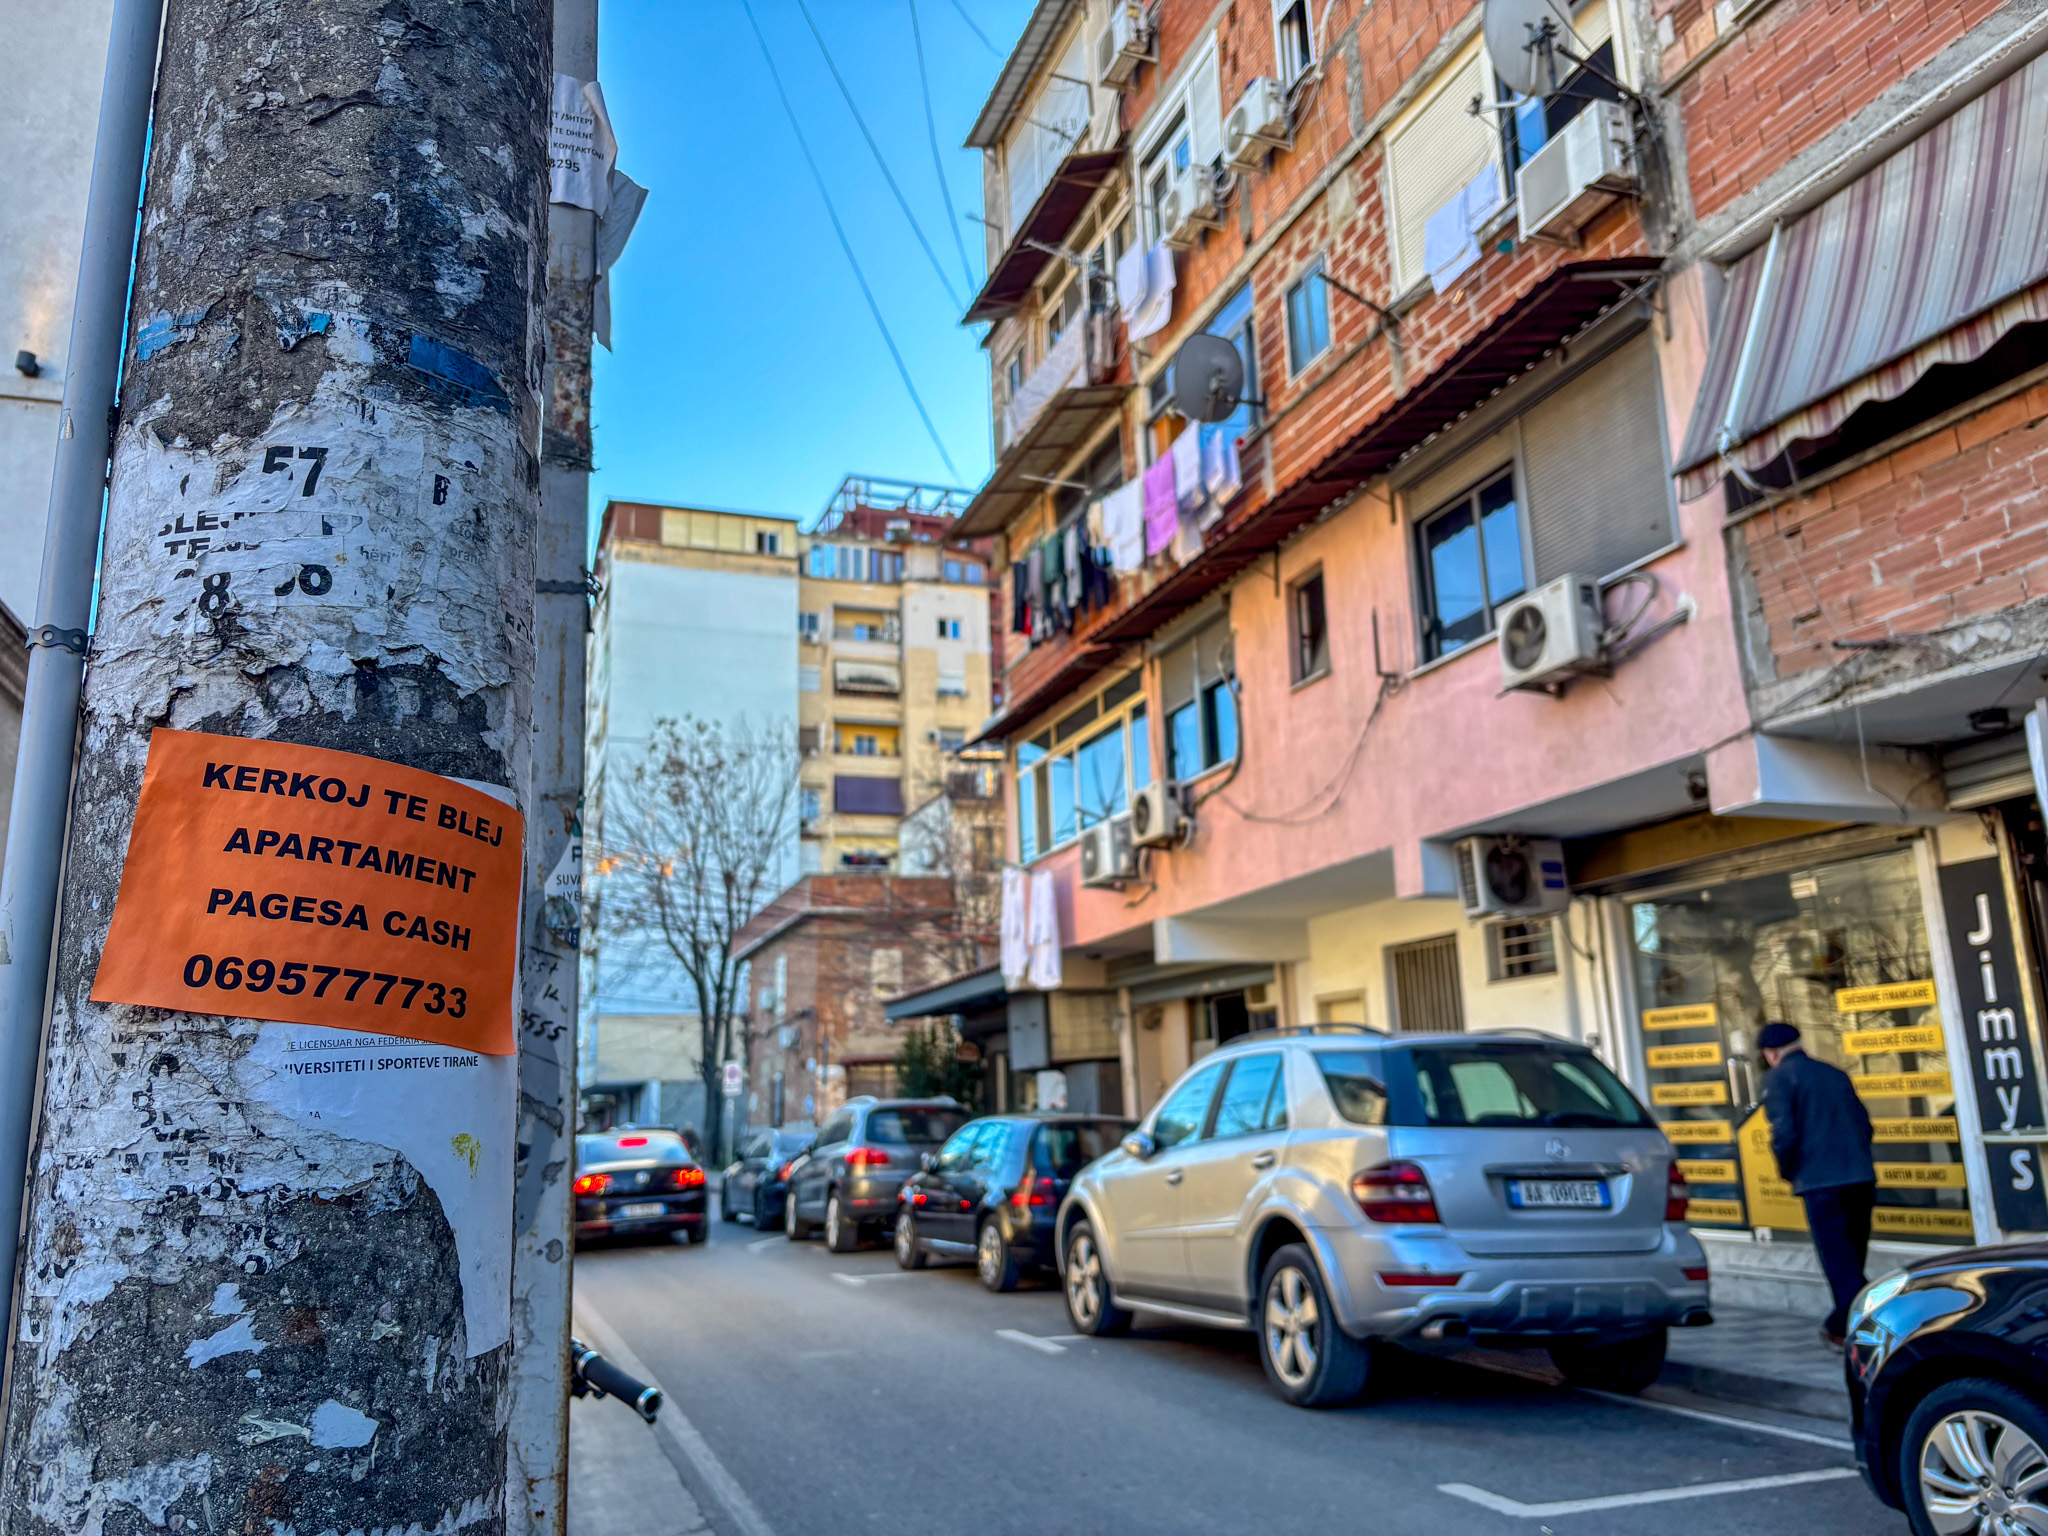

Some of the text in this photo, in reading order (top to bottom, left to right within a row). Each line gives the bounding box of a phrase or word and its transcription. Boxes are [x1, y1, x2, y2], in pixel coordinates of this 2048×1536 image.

[202, 762, 503, 848] KERKOJ TE BLEJ
[223, 827, 477, 894] APARTAMENT
[206, 888, 471, 951] PAGESA CASH
[183, 954, 468, 1019] 0695777733
[299, 1038, 352, 1050] LICENSUAR
[355, 1036, 376, 1047] NGA
[370, 1059, 374, 1071] I
[377, 1056, 440, 1071] SPORTEVE
[443, 1055, 479, 1068] TIRANE
